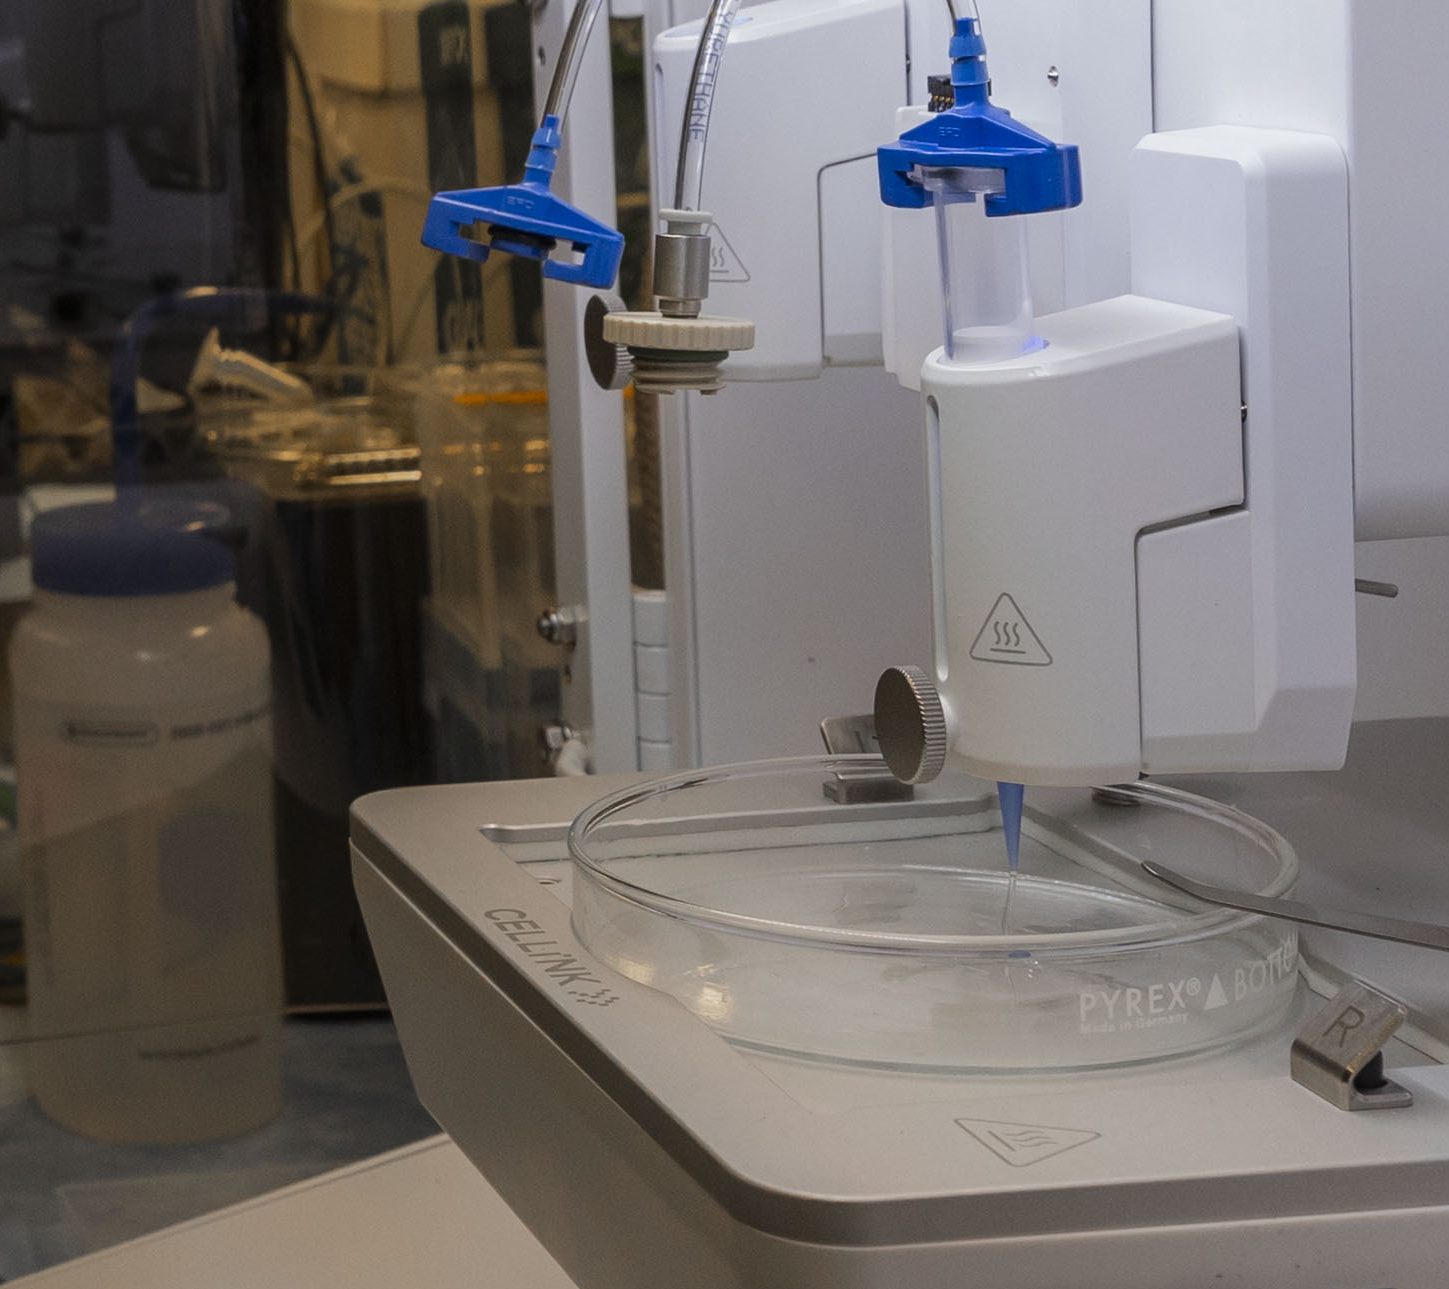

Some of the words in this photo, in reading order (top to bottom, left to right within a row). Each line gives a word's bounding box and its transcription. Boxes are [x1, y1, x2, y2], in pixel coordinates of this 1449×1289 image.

[1119, 1020, 1133, 1032] in
[1135, 1011, 1190, 1030] Germany
[1322, 1005, 1367, 1049] R
